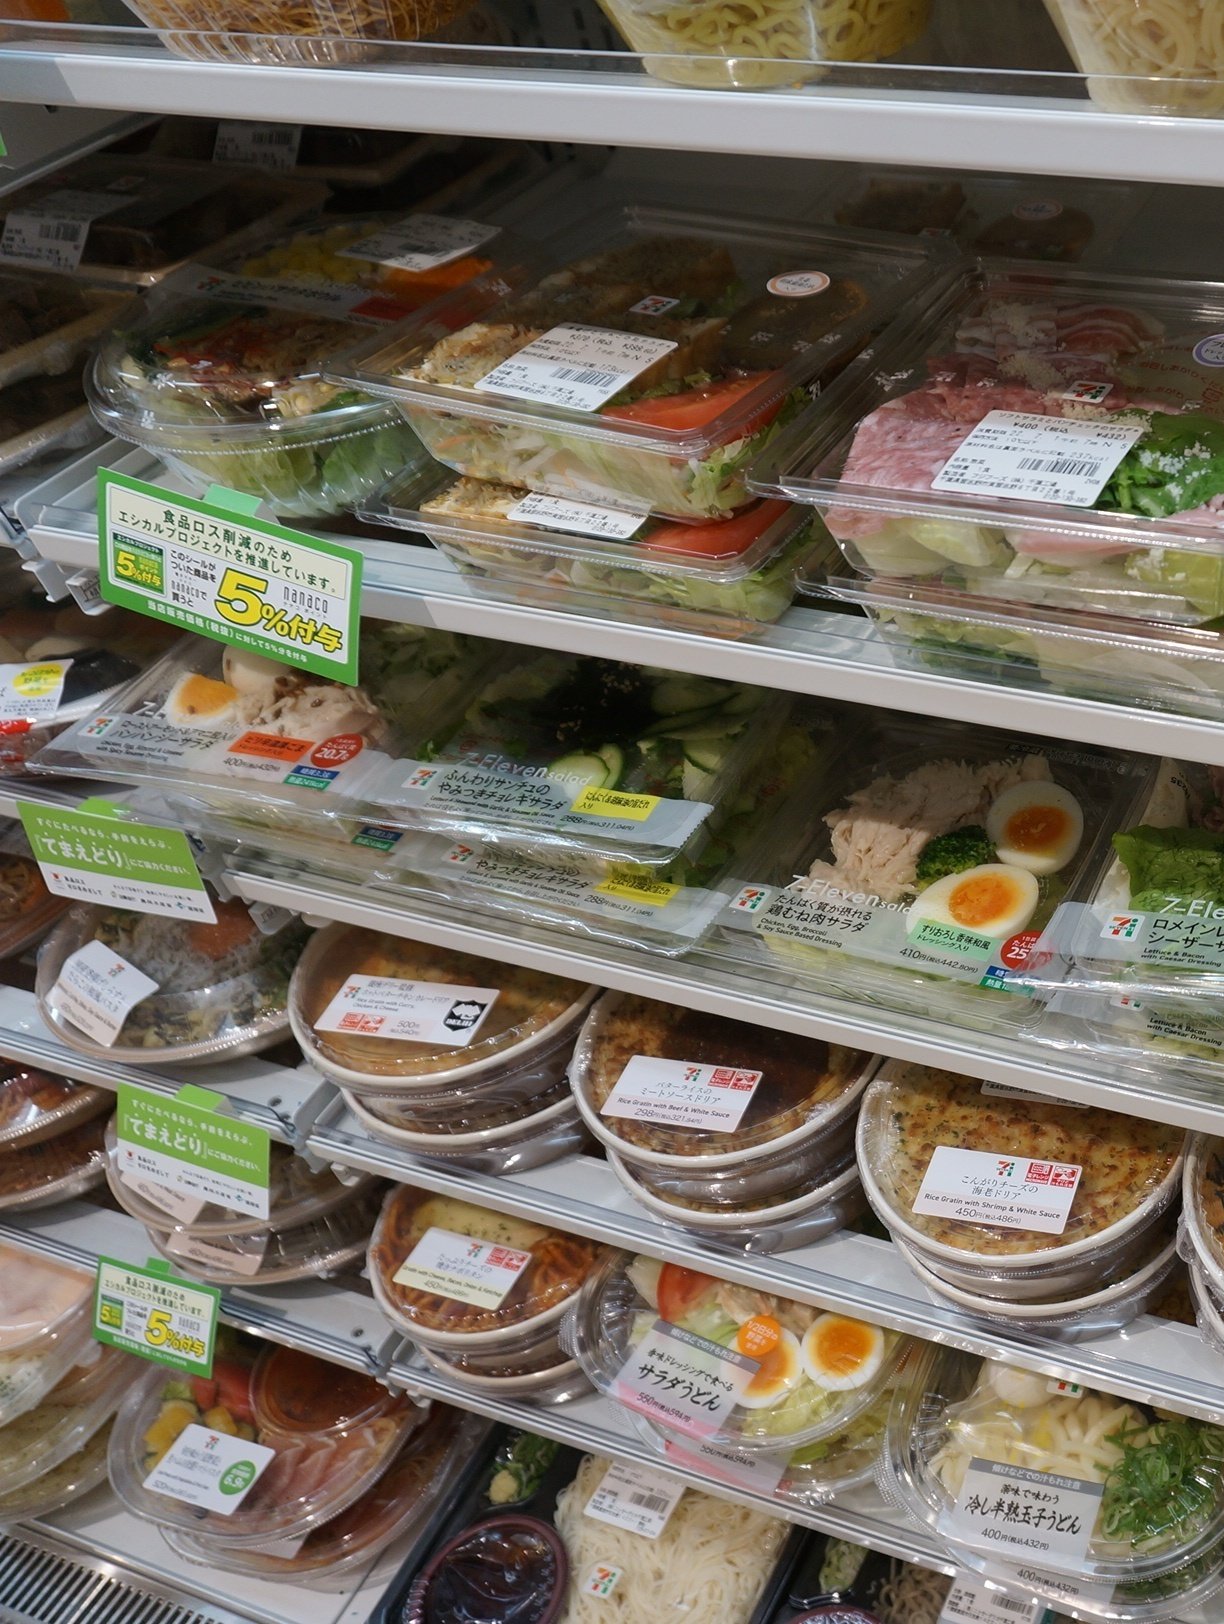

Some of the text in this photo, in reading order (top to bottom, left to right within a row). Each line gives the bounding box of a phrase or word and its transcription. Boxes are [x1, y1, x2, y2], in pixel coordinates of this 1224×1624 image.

[163, 508, 292, 563] 食品ロス削減のため
[118, 510, 337, 594] エシカルプロジェクトを推進しています。
[170, 549, 216, 572] このシールが
[170, 560, 217, 584] ついた商品を
[215, 566, 343, 654] 5%付与
[283, 585, 329, 614] nanaco
[444, 769, 551, 796] ふんわりサンチュの
[456, 752, 592, 786] 7-Eleven salad
[438, 781, 569, 811] やみつきチョレギサラダ
[475, 858, 593, 890] やみつきチョレギサラダ
[784, 873, 880, 907] 7-Eleven
[765, 902, 870, 934] 鶏むね肉サラダ
[774, 893, 873, 922] たんぱく質が摂れる
[760, 917, 828, 937] Chicken, Egg, Broccoli
[762, 922, 843, 948] Soy Sauce Based Dressing
[921, 924, 992, 951] すりおろし香味和風
[916, 933, 970, 952] ドレッシング入り
[1143, 948, 1206, 960] Lettuce Bacon
[899, 947, 979, 974] 410円(税込442.80円)
[1158, 955, 1186, 963] Caesar
[1187, 958, 1222, 968] Dressing
[1147, 1023, 1223, 1047] with Caesar Dressing
[1149, 1017, 1208, 1036] Lettuce Bacon
[641, 1087, 721, 1105] ミートソースドリア
[961, 1175, 1039, 1194] こんがりチーズの
[971, 1186, 1022, 1200] 海老ドリア
[924, 1193, 1061, 1219] Rice Gratin with Shrimp White Sauce
[955, 1207, 1022, 1225] 450円(税込486円)
[144, 1308, 206, 1358] 5%付与
[647, 1348, 734, 1392] 香味ドレッシングで食べる
[637, 1363, 721, 1412] サラダうどん
[991, 1463, 1081, 1490] 傾けなどでの汁もれ注意
[1000, 1483, 1060, 1505] 薬味で味わう
[964, 1493, 1082, 1536] 冷し半熟玉子うどん
[981, 1527, 1050, 1551] 400円(税込432円)
[1017, 1568, 1080, 1595] 400円(税込432円)
